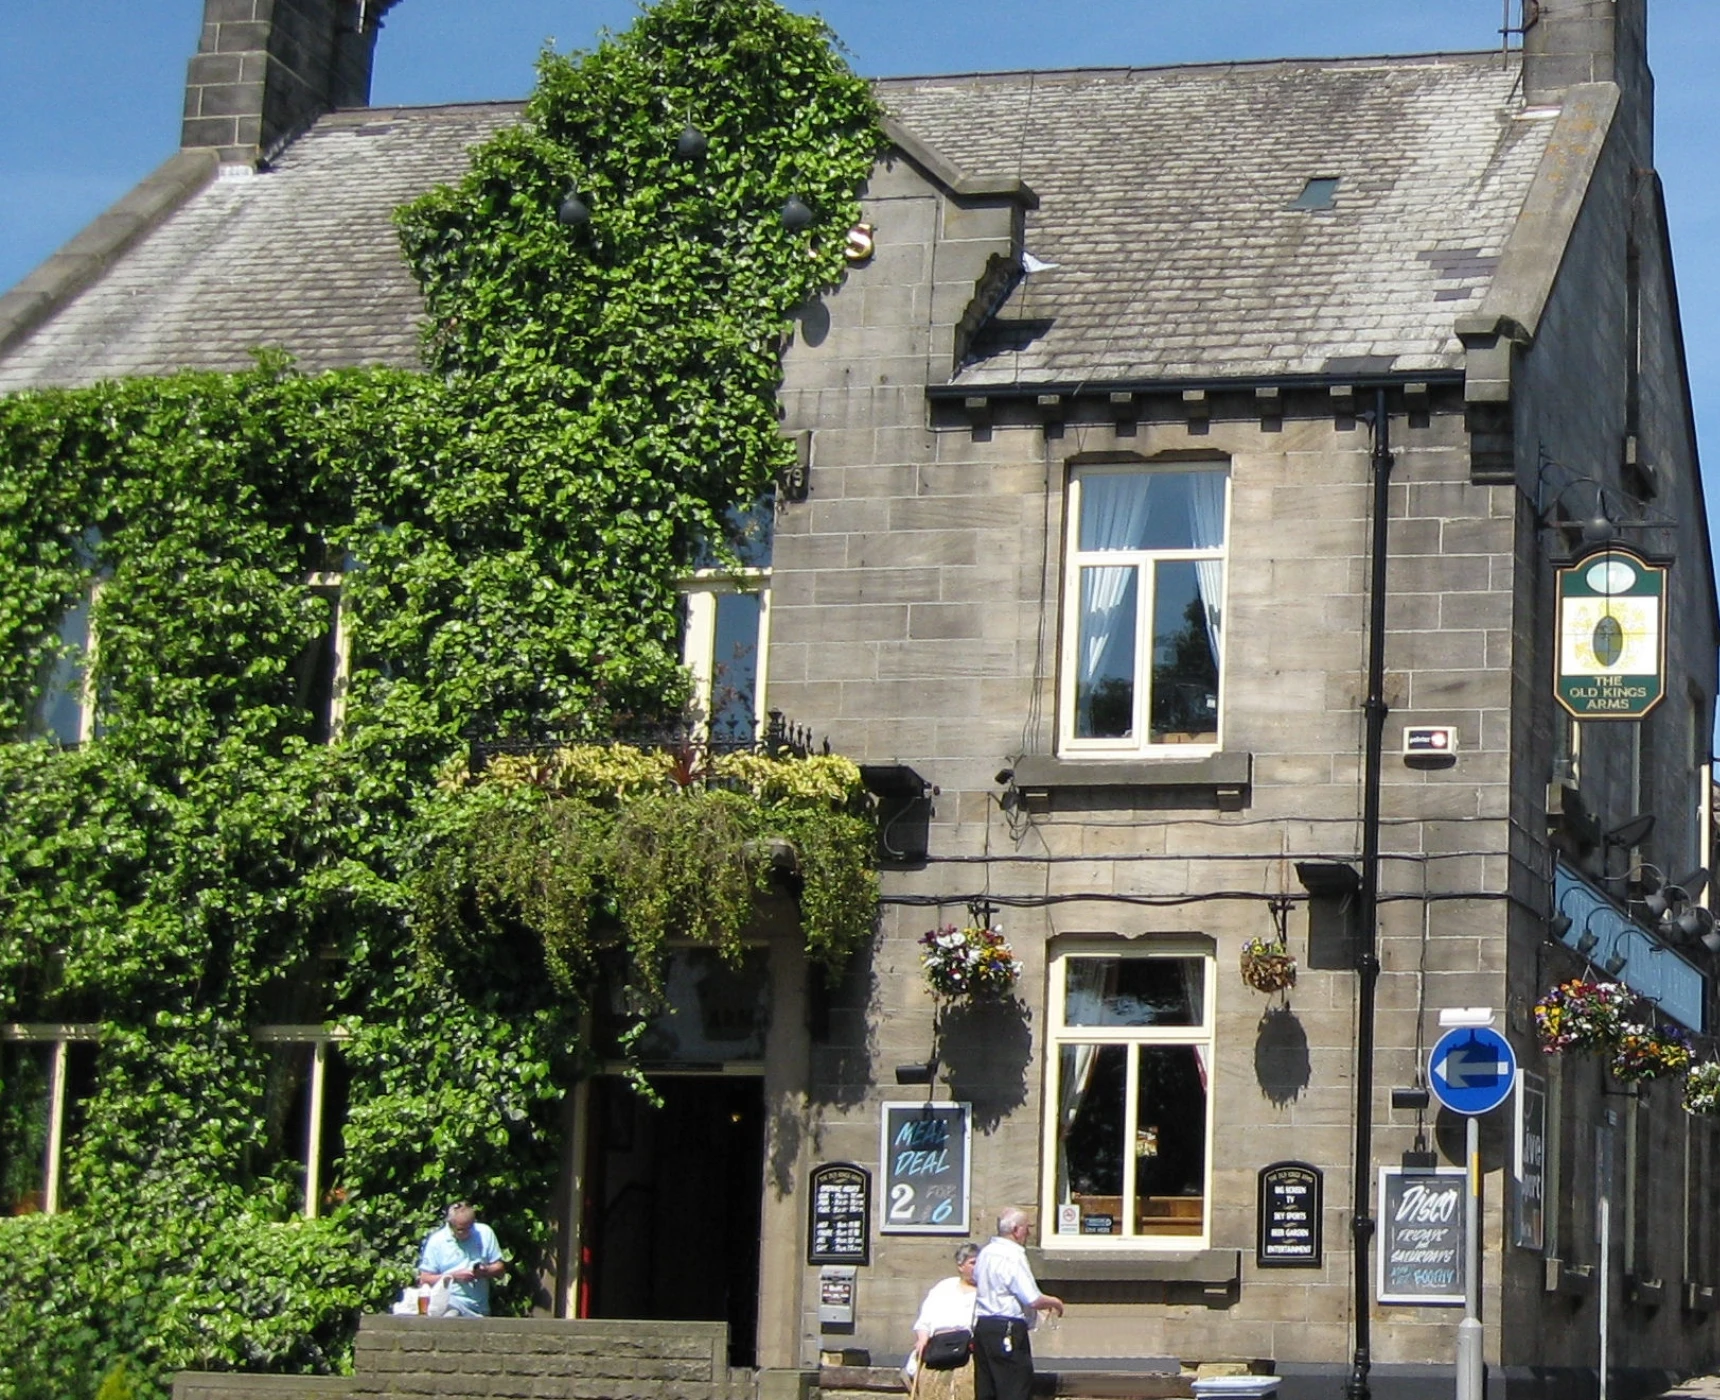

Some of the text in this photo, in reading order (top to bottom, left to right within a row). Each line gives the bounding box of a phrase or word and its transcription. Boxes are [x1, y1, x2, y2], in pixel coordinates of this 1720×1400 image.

[1594, 676, 1622, 686] THE
[1569, 687, 1647, 697] OLD KINGS
[1586, 699, 1629, 709] ARMS
[895, 1120, 950, 1146] MEAL
[895, 1149, 950, 1176] DEAL
[890, 1183, 915, 1219] 2
[1286, 1195, 1296, 1203] TV
